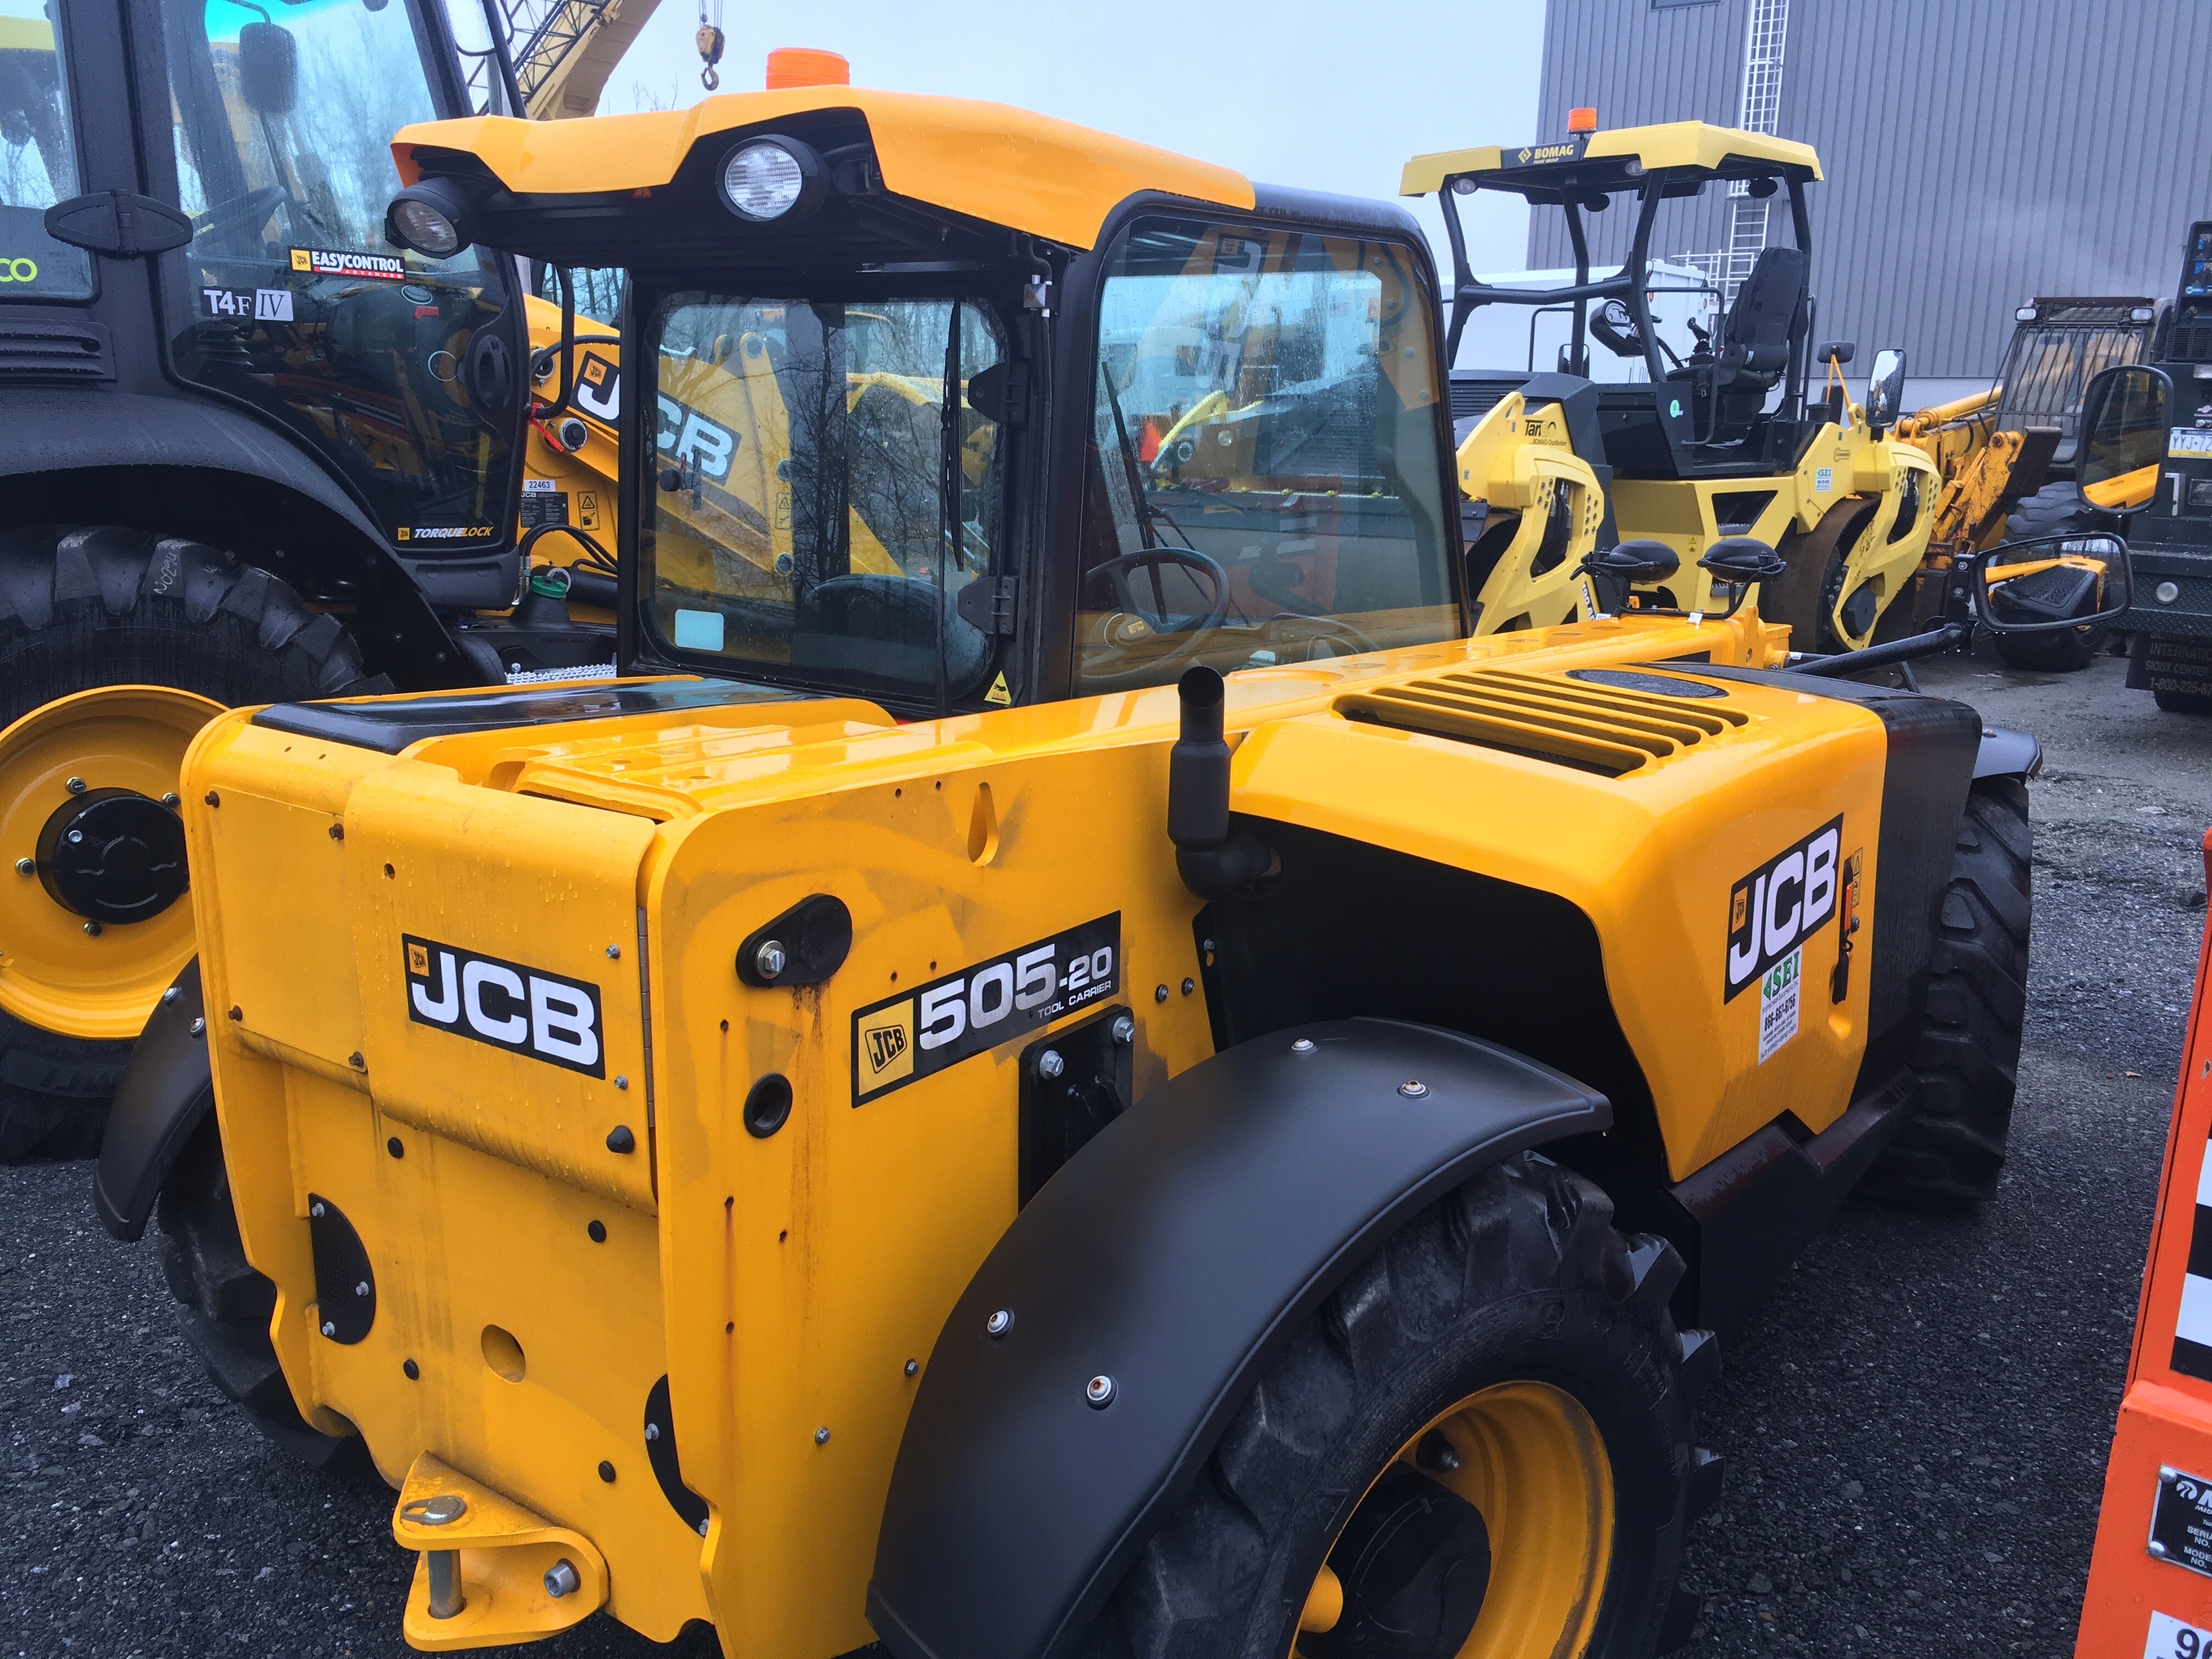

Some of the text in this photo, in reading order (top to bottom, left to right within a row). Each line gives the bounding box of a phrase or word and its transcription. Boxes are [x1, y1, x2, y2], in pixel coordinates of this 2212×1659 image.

[1534, 144, 1574, 159] BOMAG
[312, 251, 404, 272] EASYCONTROL
[345, 269, 402, 279] ADVANCED
[258, 293, 286, 317] IV
[1820, 469, 1831, 477] SEI
[414, 527, 494, 538] TORQUELOCK
[1730, 828, 1838, 985] JCB
[1772, 950, 1800, 997] SEI
[919, 943, 1113, 1050] 505-20
[1037, 980, 1111, 1019] TOOL CARRIER
[412, 951, 599, 1065] JCB
[873, 1026, 905, 1068] JCB
[2194, 1536, 2210, 1548] NO.
[2183, 1546, 2212, 1564] MODE
[2191, 1557, 2207, 1568] NO.
